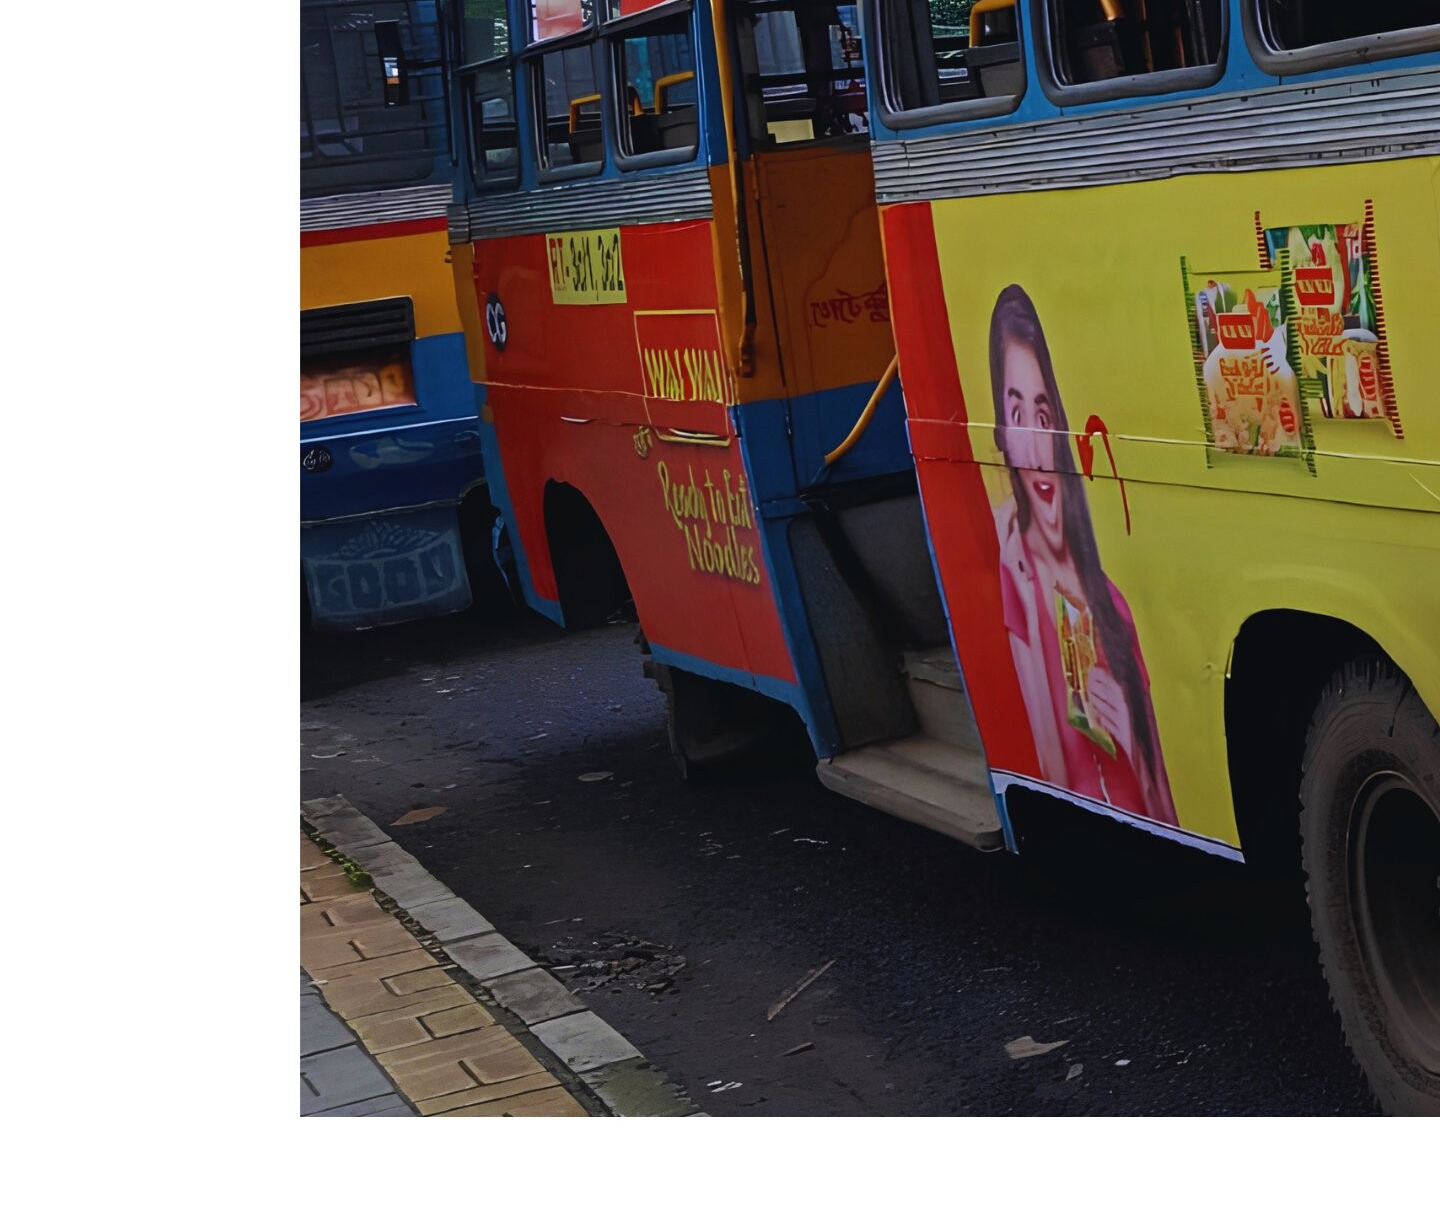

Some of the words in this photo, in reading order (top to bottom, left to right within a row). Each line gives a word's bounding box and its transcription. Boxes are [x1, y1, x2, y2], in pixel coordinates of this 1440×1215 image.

[486, 302, 507, 344] CG
[645, 347, 685, 402] WAI
[684, 523, 761, 585] Noodles
